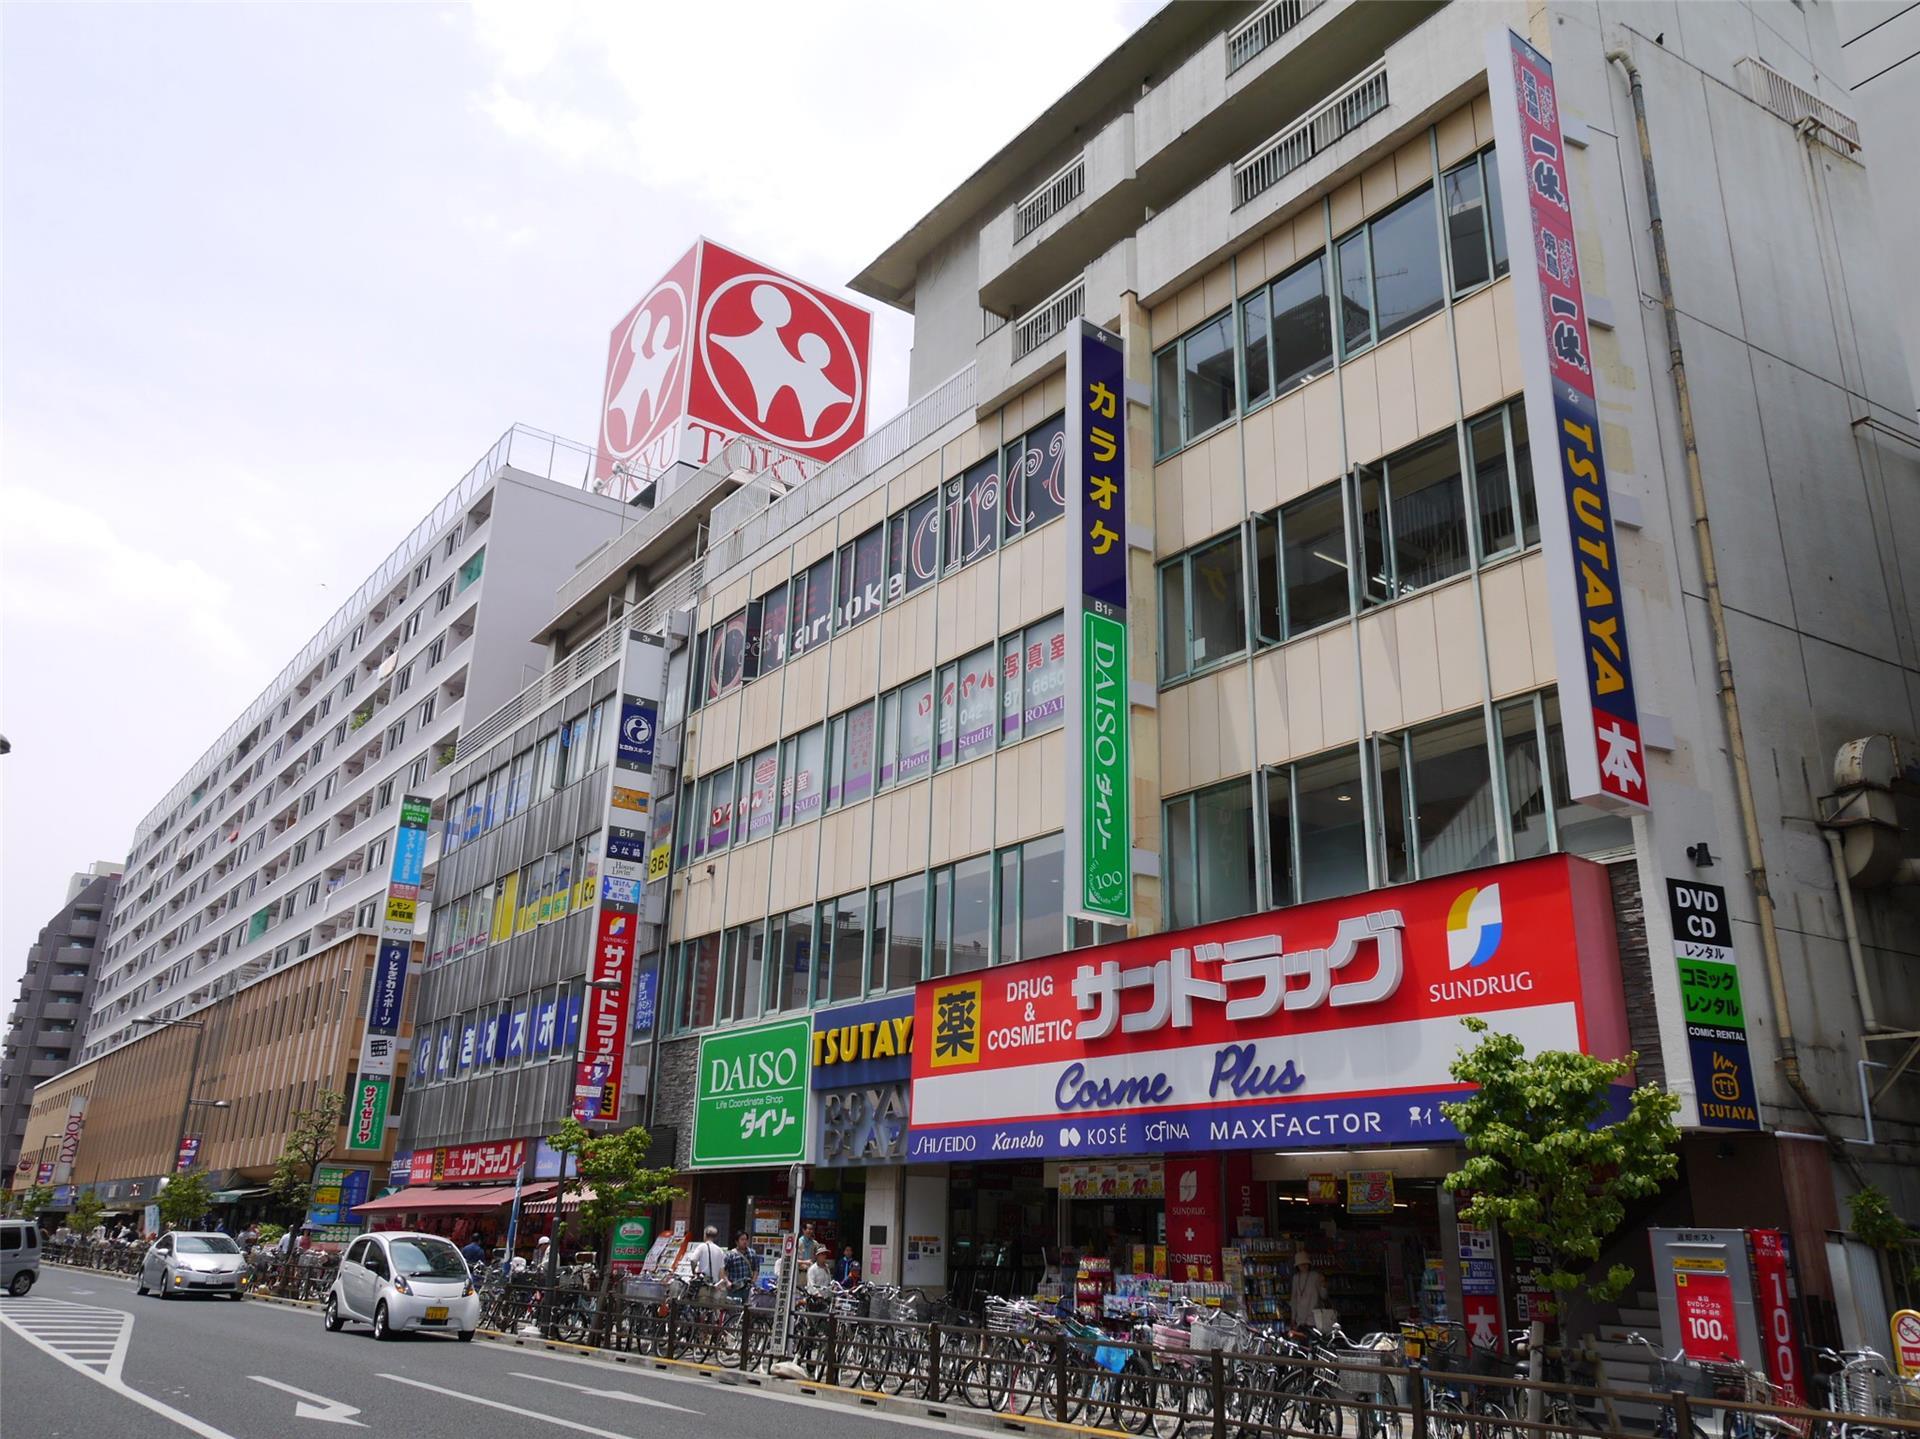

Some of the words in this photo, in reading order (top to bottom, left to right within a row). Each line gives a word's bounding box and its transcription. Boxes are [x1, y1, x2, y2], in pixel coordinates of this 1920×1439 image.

[1531, 133, 1566, 209] 一休
[1551, 294, 1587, 373] 一休
[1089, 381, 1119, 556] カラオケ
[1563, 417, 1625, 697] TSUTAYA
[1095, 601, 1113, 617] B1F
[1095, 638, 1117, 767] DAISO
[1597, 722, 1643, 794] 本
[1096, 772, 1112, 852] ダイソー
[1096, 870, 1123, 890] 100
[615, 903, 624, 911] 1F
[1675, 886, 1719, 913] DVD
[1687, 914, 1716, 938] CD
[1685, 943, 1725, 960] レンタル
[1006, 975, 1054, 1003] DRUG
[1071, 909, 1406, 1040] サンドラッグ
[1429, 971, 1533, 1003] SUNDRUG
[1682, 967, 1735, 991] コミック
[380, 960, 399, 1026] ときわスポーツ
[1685, 993, 1740, 1017] レンタル
[935, 989, 976, 1057] 薬
[1024, 1001, 1036, 1022] &
[812, 1015, 915, 1067] TSUTAY
[987, 1018, 1073, 1051] COSMETIC
[1688, 1026, 1716, 1039] COMIC
[1716, 1029, 1745, 1041] RENTAL
[709, 1047, 797, 1094] DAISO
[1055, 1062, 1173, 1112] Cosme
[1208, 1043, 1306, 1097] Plus
[358, 1086, 377, 1144] サイゼリヤ
[715, 1100, 728, 1110] Life
[766, 1095, 784, 1105] Shop
[824, 1083, 910, 1127] ROYA
[1702, 1103, 1756, 1121] TSUTAYA
[60, 1112, 83, 1163] TOKYU
[740, 1107, 796, 1140] ダイソー
[911, 1135, 976, 1155] SHISEIDO
[991, 1130, 1044, 1151] Kanebo
[1087, 1123, 1127, 1145] KOSÉ
[461, 1144, 511, 1176] サンドラッグ
[1172, 1206, 1205, 1216] SUNDRUG
[1170, 1253, 1211, 1265] COSMETIC
